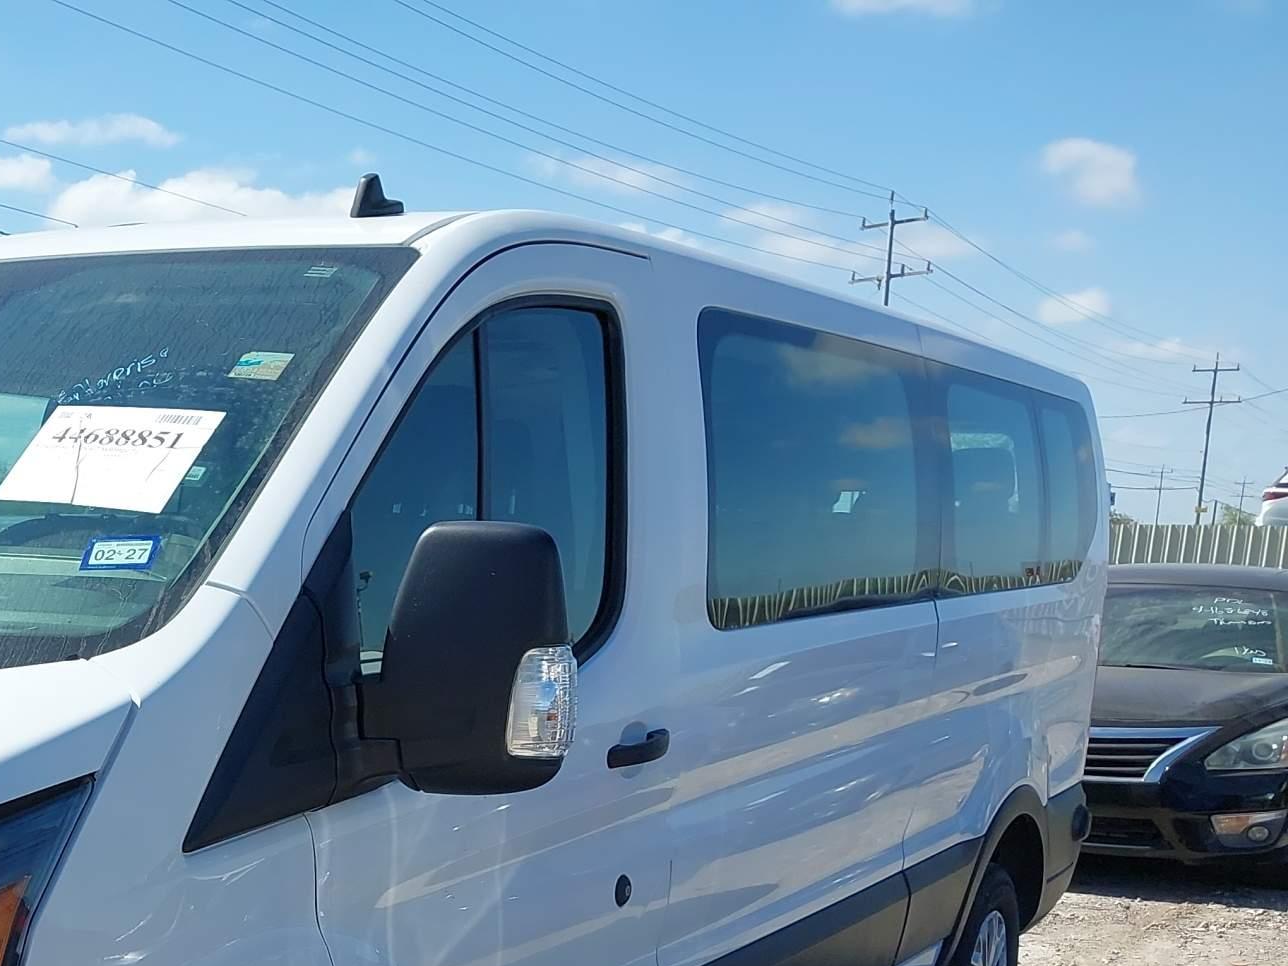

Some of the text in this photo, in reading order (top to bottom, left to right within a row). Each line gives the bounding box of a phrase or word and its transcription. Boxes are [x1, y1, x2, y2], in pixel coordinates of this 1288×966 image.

[51, 426, 185, 449] 44688851
[94, 547, 149, 561] 02 27
